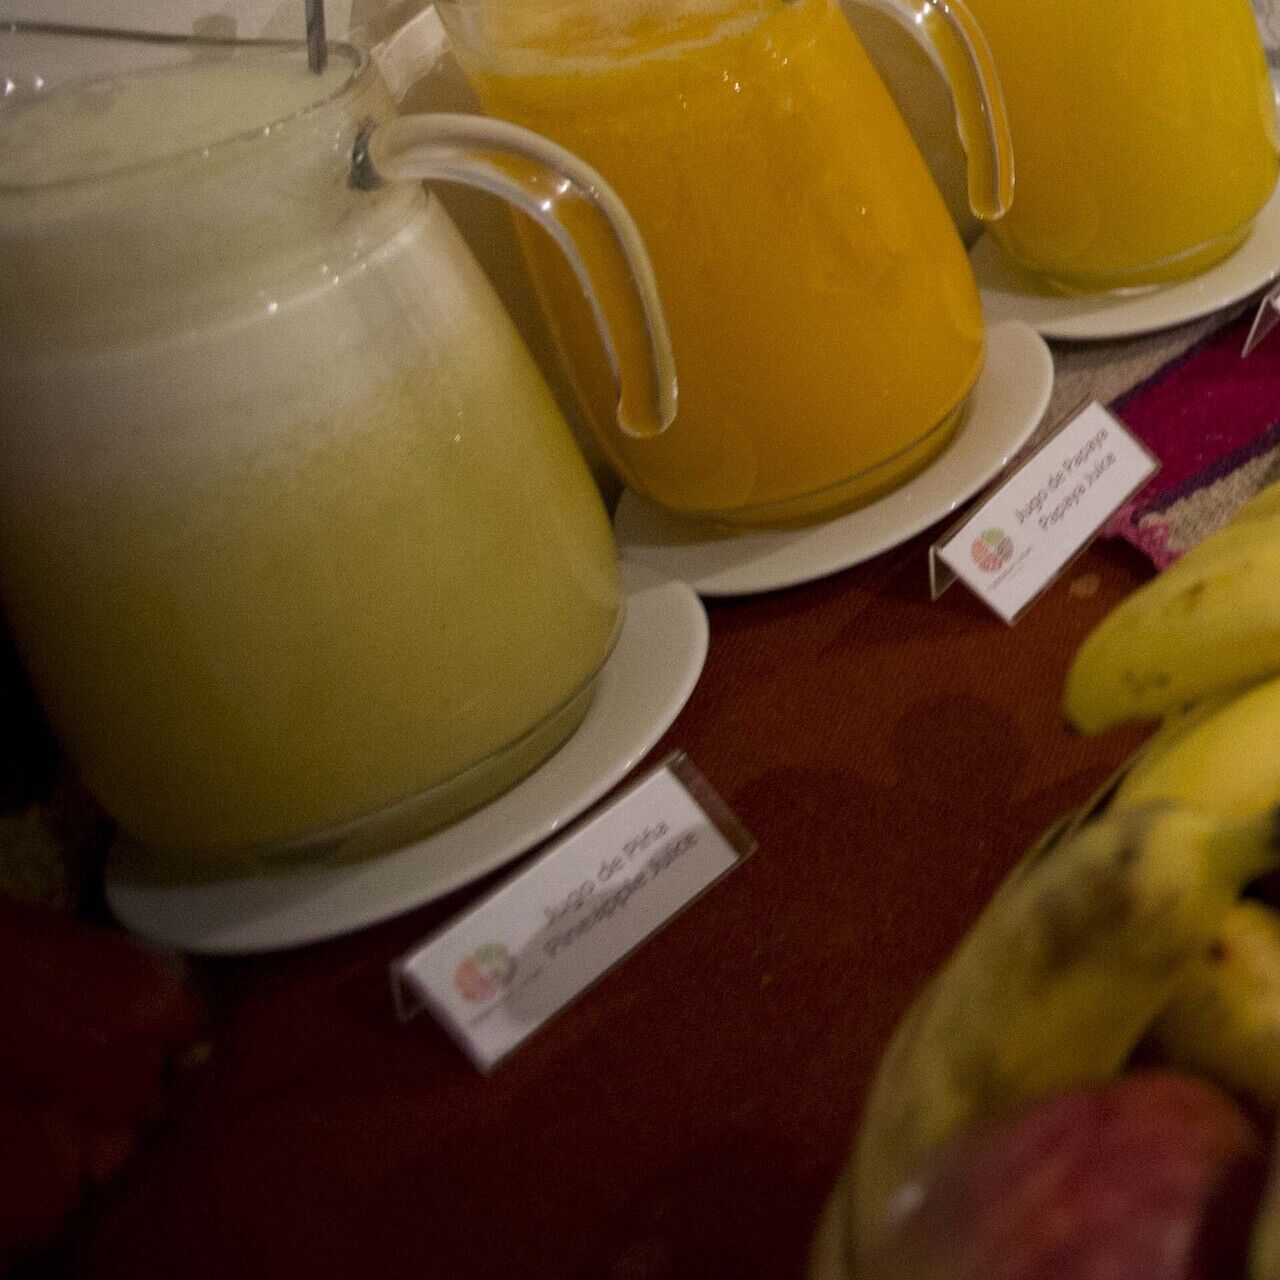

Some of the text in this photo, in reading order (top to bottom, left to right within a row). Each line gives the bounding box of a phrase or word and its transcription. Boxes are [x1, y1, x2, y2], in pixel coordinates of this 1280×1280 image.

[1014, 427, 1108, 524] Jugo de Papaya
[1038, 451, 1117, 531] Papaya Juice
[541, 820, 670, 926] Jugo de Piña
[543, 831, 699, 957] Pineapple Juice
